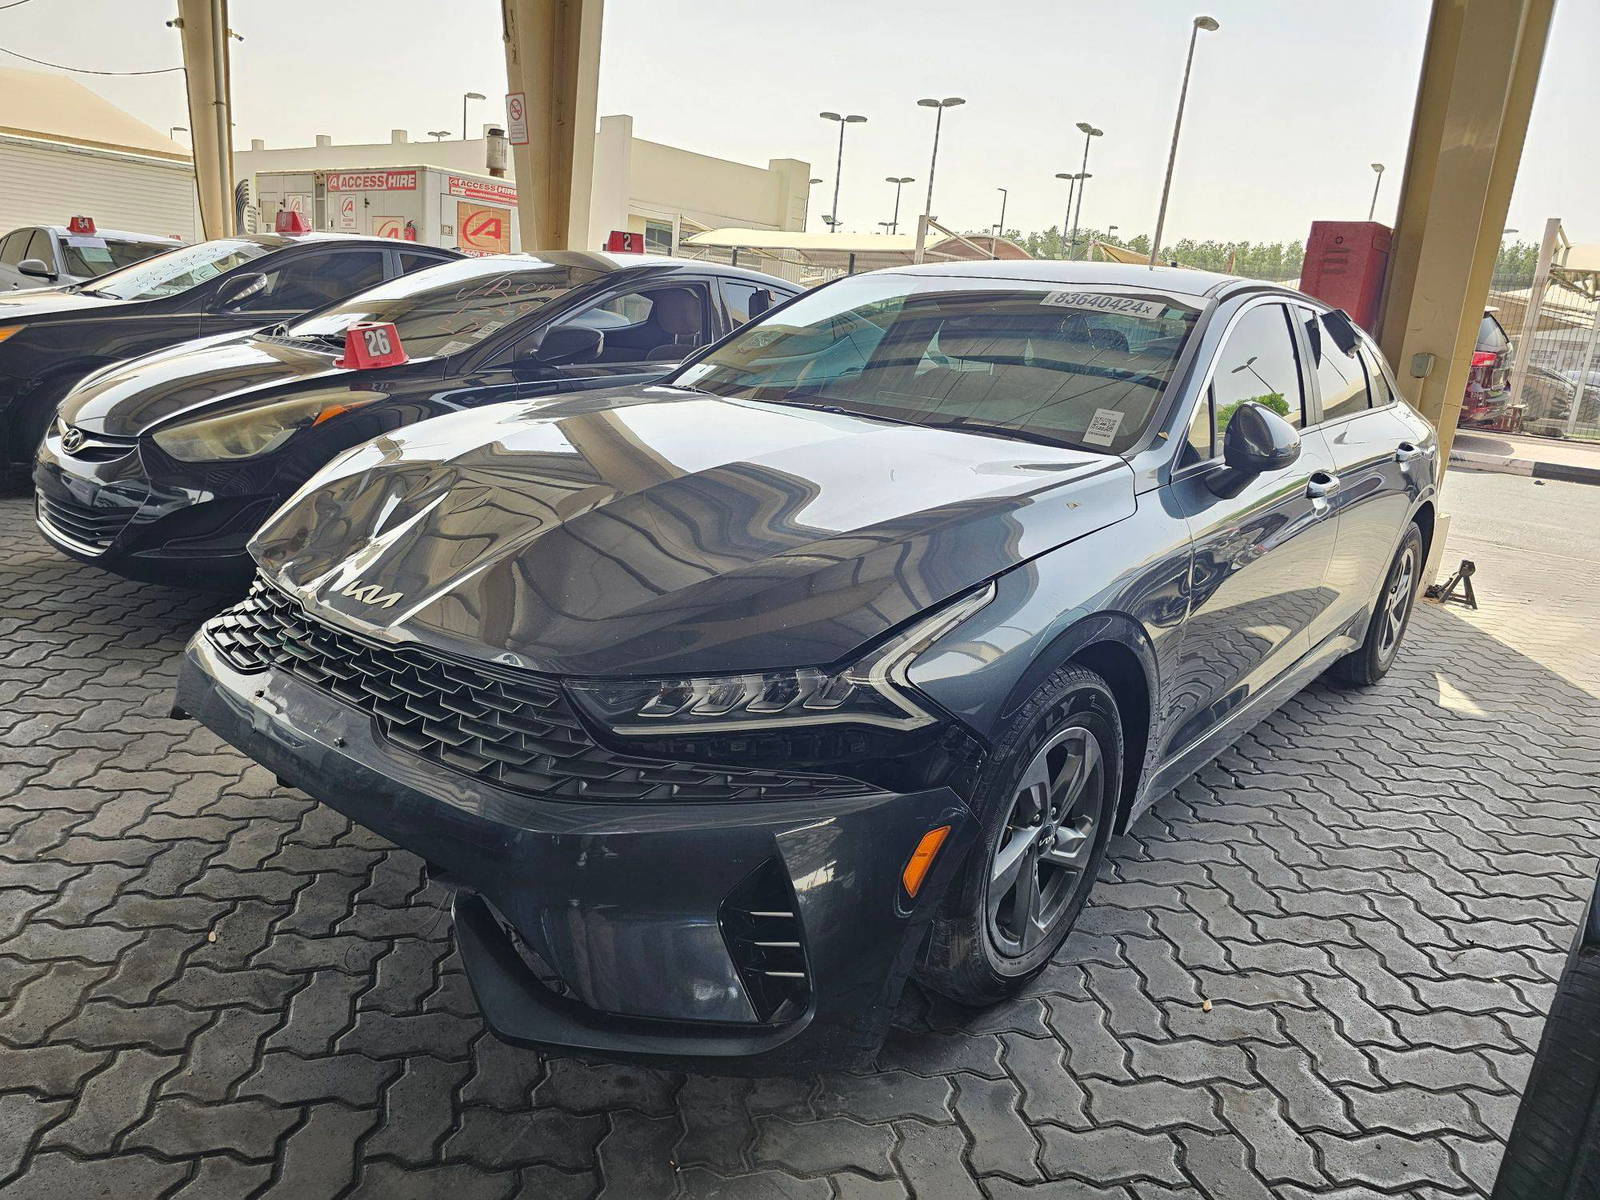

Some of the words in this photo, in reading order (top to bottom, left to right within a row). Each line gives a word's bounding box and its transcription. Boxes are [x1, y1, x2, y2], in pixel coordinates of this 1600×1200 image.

[341, 175, 385, 188] ACCESS
[389, 174, 416, 188] HIRE
[460, 180, 496, 191] ACCESS
[498, 186, 517, 196] HIR
[79, 218, 90, 229] 54
[624, 233, 632, 251] 2
[364, 328, 391, 357] 26
[341, 580, 404, 609] KIA
